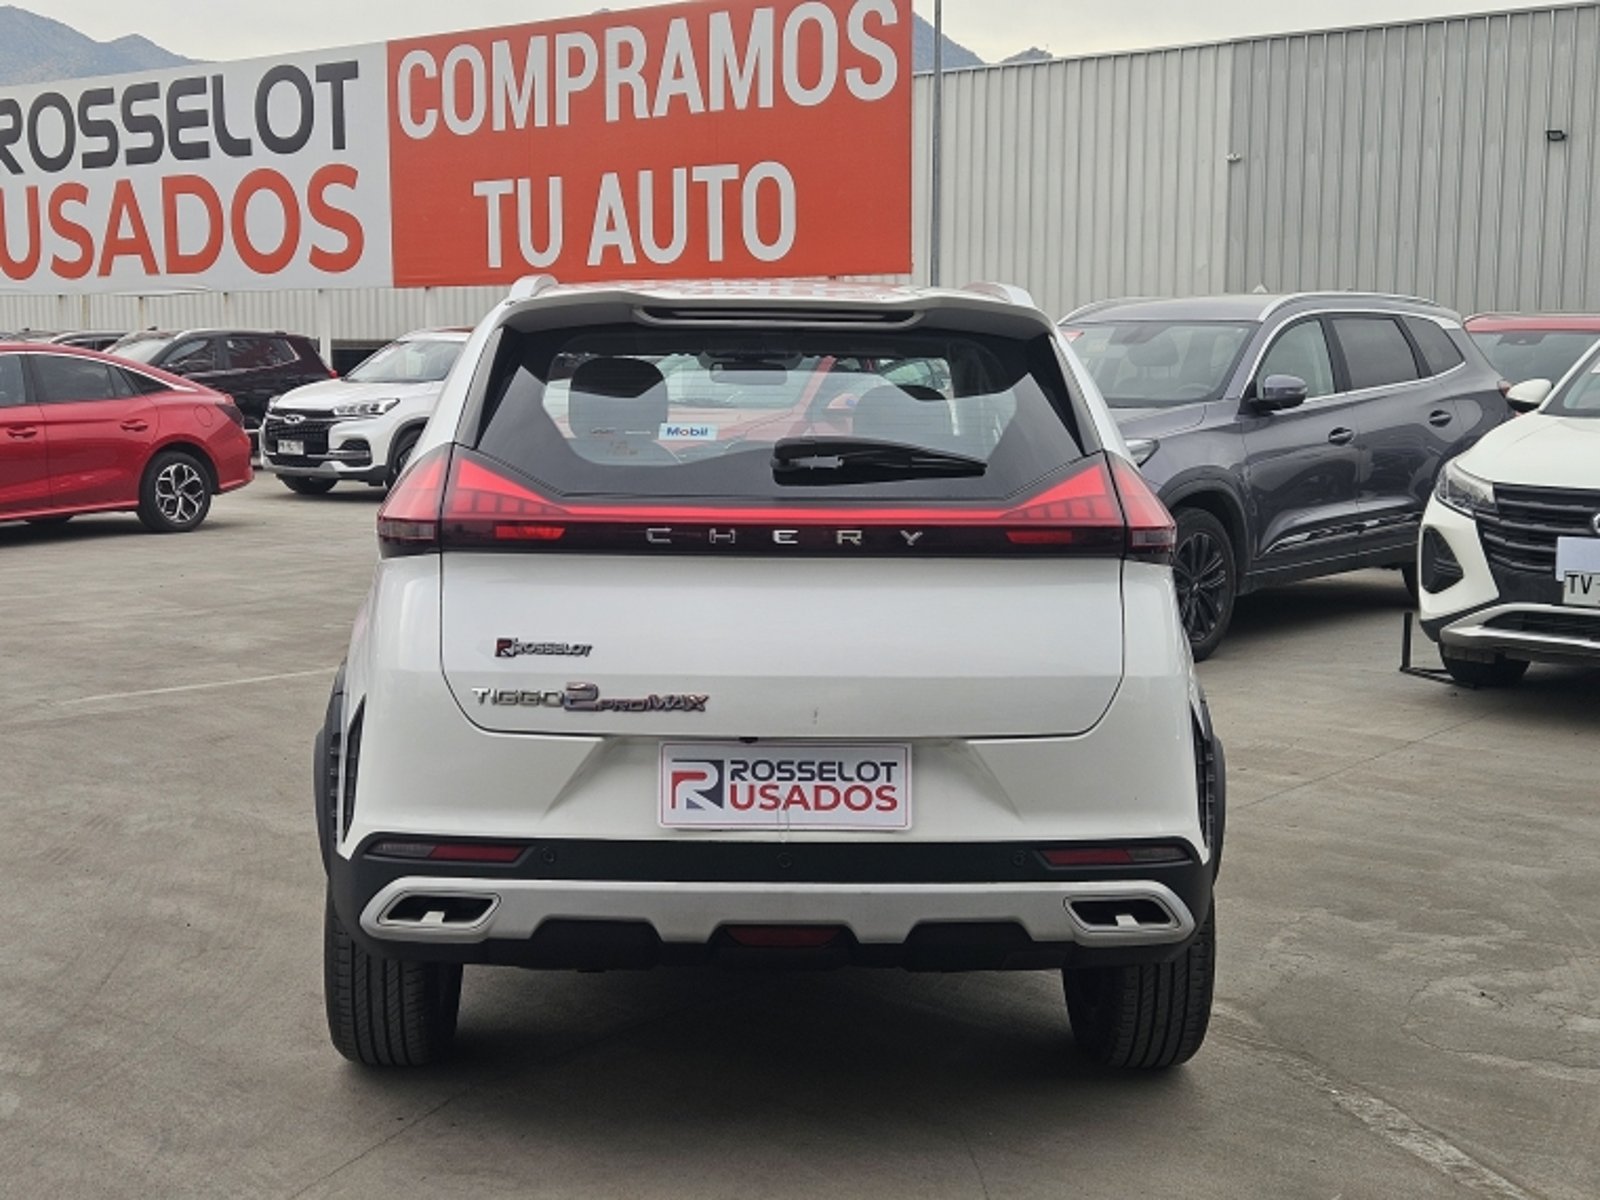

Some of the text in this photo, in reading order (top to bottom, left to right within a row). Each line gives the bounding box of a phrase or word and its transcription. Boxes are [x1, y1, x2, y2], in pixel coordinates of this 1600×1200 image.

[397, 0, 899, 140] COMPRAMOS
[0, 60, 359, 175] ROSSELOT
[0, 163, 365, 280] USADOS
[473, 161, 797, 269] TU AUTO
[666, 426, 709, 437] Mobil
[645, 527, 924, 546] CHERY
[729, 759, 898, 783] ROSSELOT
[729, 784, 898, 812] USADOS
